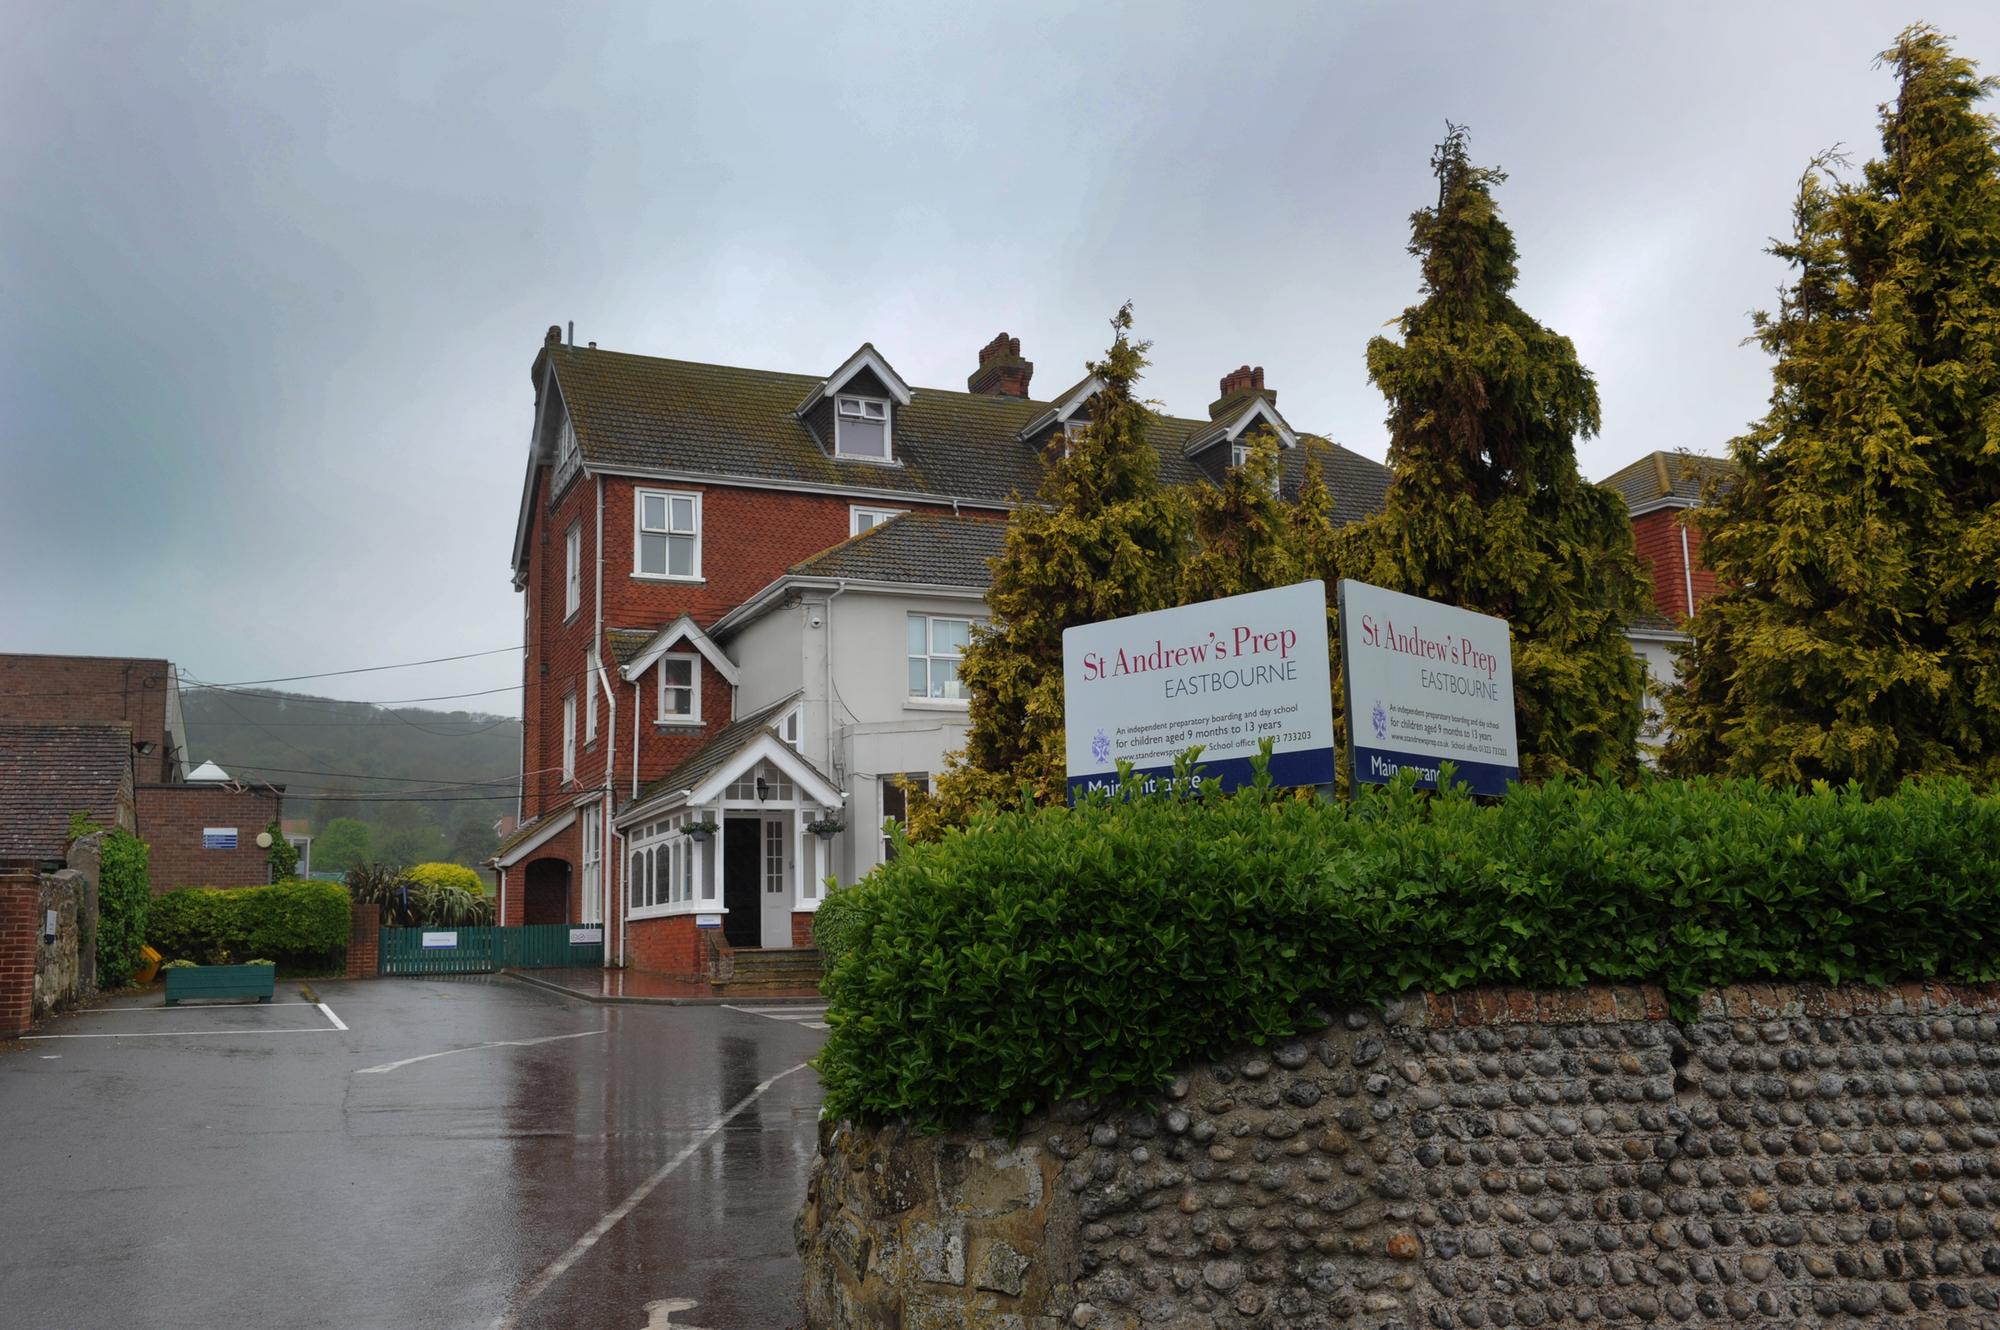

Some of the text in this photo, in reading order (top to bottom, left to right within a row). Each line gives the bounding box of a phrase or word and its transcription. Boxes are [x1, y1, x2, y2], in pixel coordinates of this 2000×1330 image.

[1083, 626, 1297, 681] St Andrew's Prep
[1362, 614, 1497, 680] St Andrew's Prep
[1165, 660, 1297, 699] EASTBOURNE
[1421, 669, 1499, 701] EASTBOURNE
[1116, 704, 1298, 735] An independent preparatory boarding and day school
[1116, 720, 1282, 749] for children aged 9 months to 13 years
[1390, 717, 1399, 727] for
[1401, 719, 1424, 731] children
[1424, 723, 1437, 735] aged
[1443, 726, 1463, 737] months
[1464, 729, 1470, 738] to
[1471, 729, 1478, 739] 13
[1479, 732, 1492, 742] years
[1209, 740, 1233, 751] School
[1236, 738, 1256, 748] office
[1283, 730, 1312, 742] 733203
[1371, 755, 1398, 777] Main
